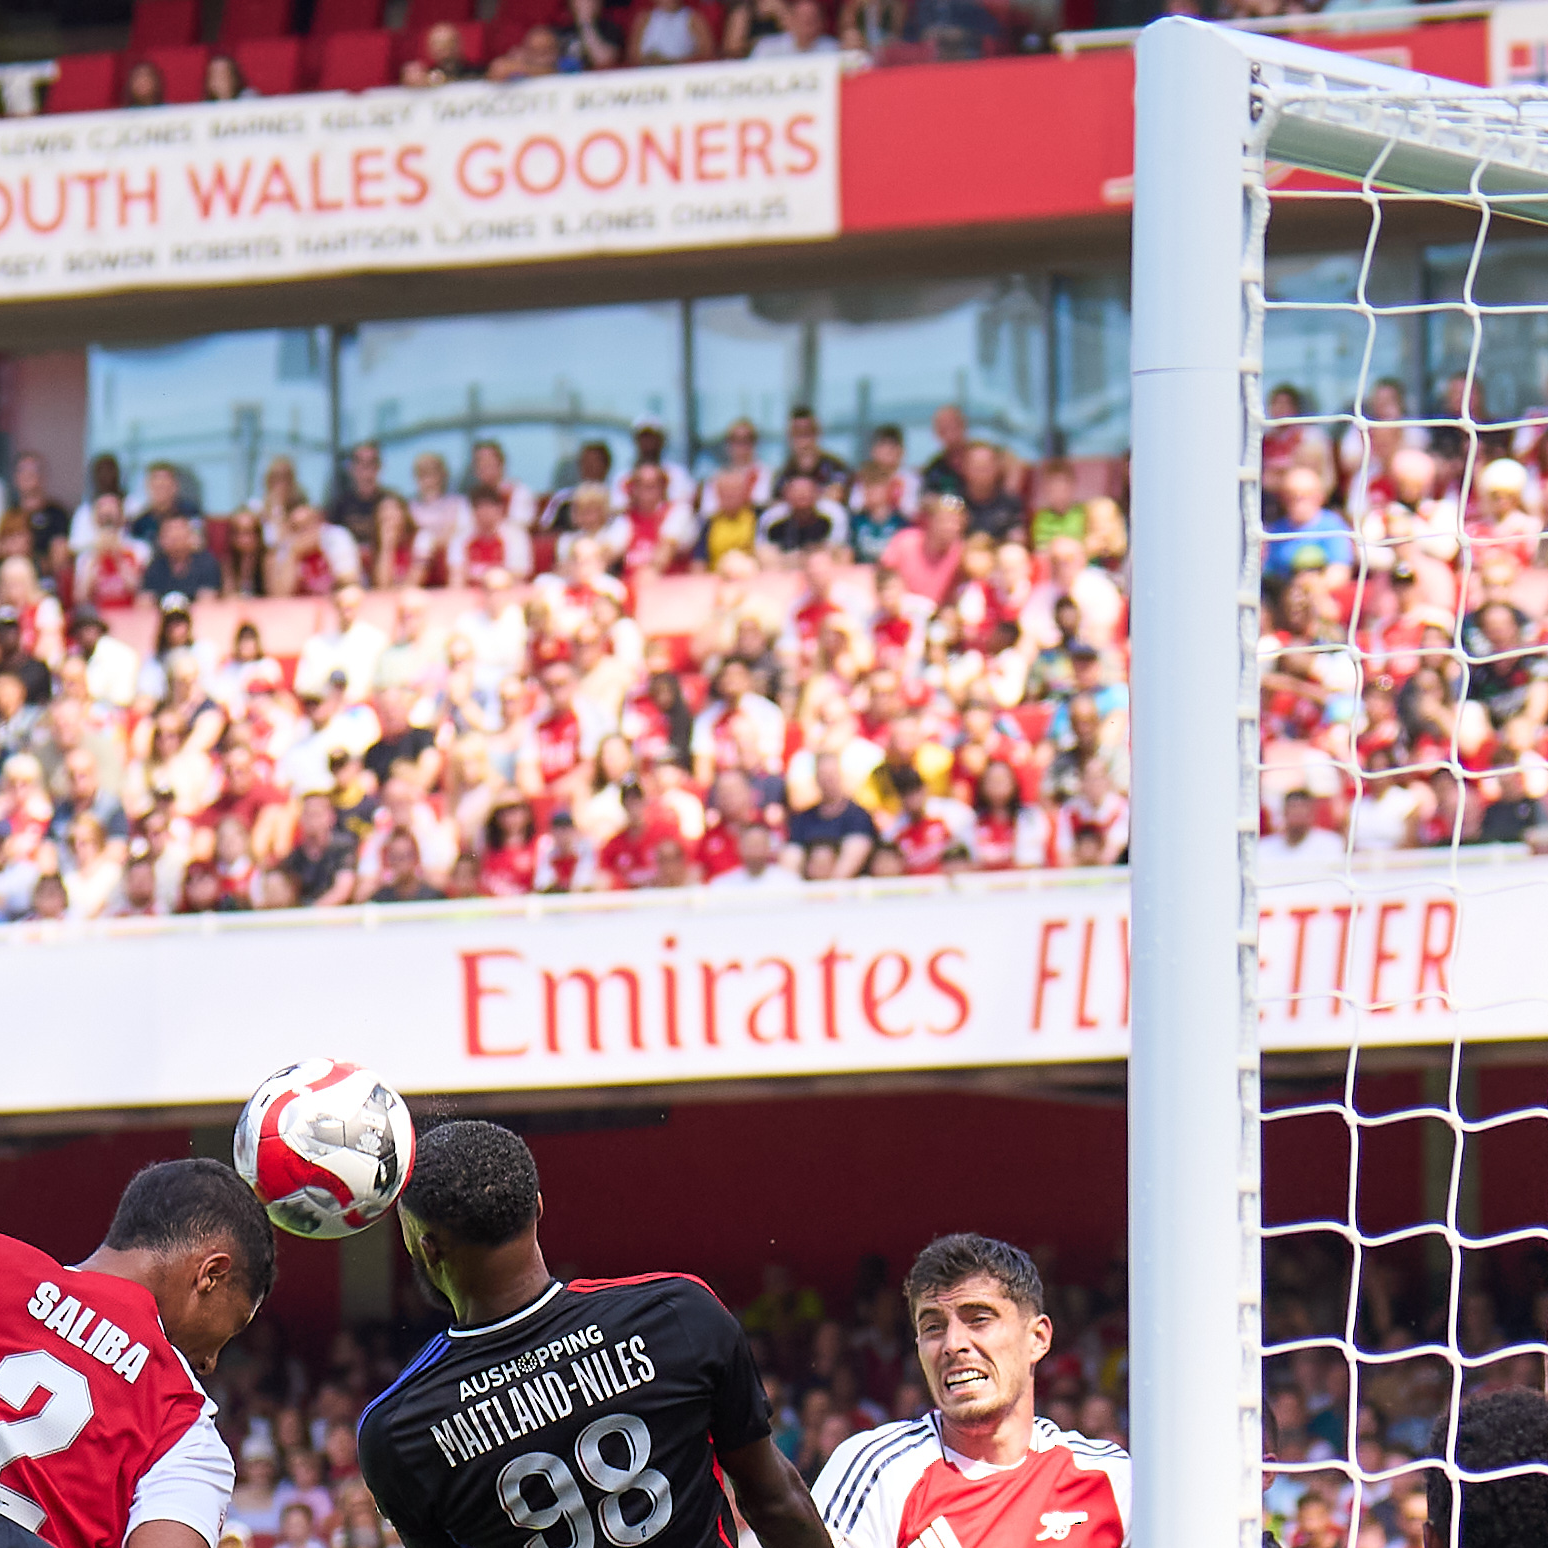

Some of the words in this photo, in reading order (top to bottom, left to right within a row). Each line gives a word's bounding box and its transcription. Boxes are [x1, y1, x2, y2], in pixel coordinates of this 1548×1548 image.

[186, 143, 430, 221] WALES
[456, 112, 821, 201] GOONERS
[457, 932, 975, 1061] Emirates
[1258, 902, 1456, 1019] TTER
[27, 1281, 150, 1384] SALIBA
[430, 1334, 656, 1468] MAITLAND-NILES
